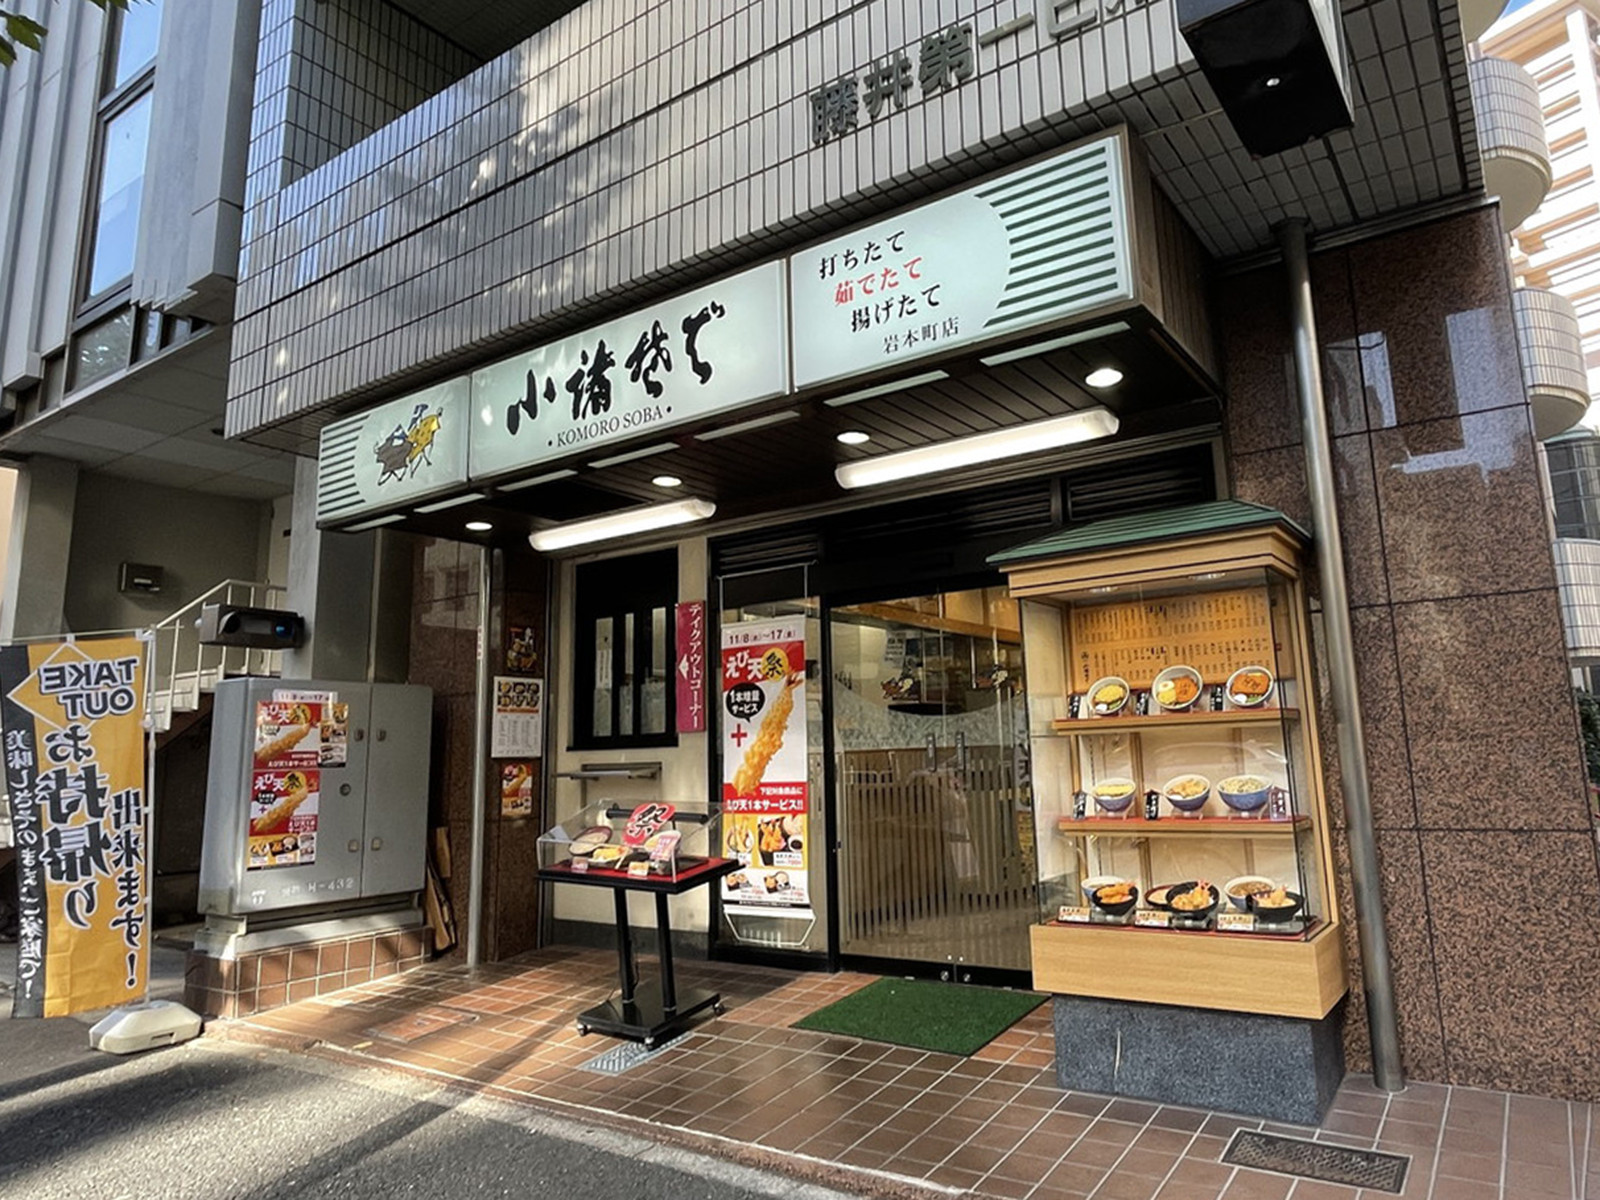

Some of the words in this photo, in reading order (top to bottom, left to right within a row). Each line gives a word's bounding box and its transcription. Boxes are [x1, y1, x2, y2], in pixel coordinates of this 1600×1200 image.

[810, 0, 1144, 144] 藤井第一ビ
[819, 230, 905, 280] 打ちたて
[834, 257, 922, 307] 茹でたて
[851, 284, 940, 333] 揚げたて
[883, 316, 959, 354] 岩本町店
[556, 418, 620, 448] KOMORO
[622, 406, 663, 438] SOBA
[689, 604, 702, 729] テイクアウトコーナー
[725, 649, 784, 680] えび天祭
